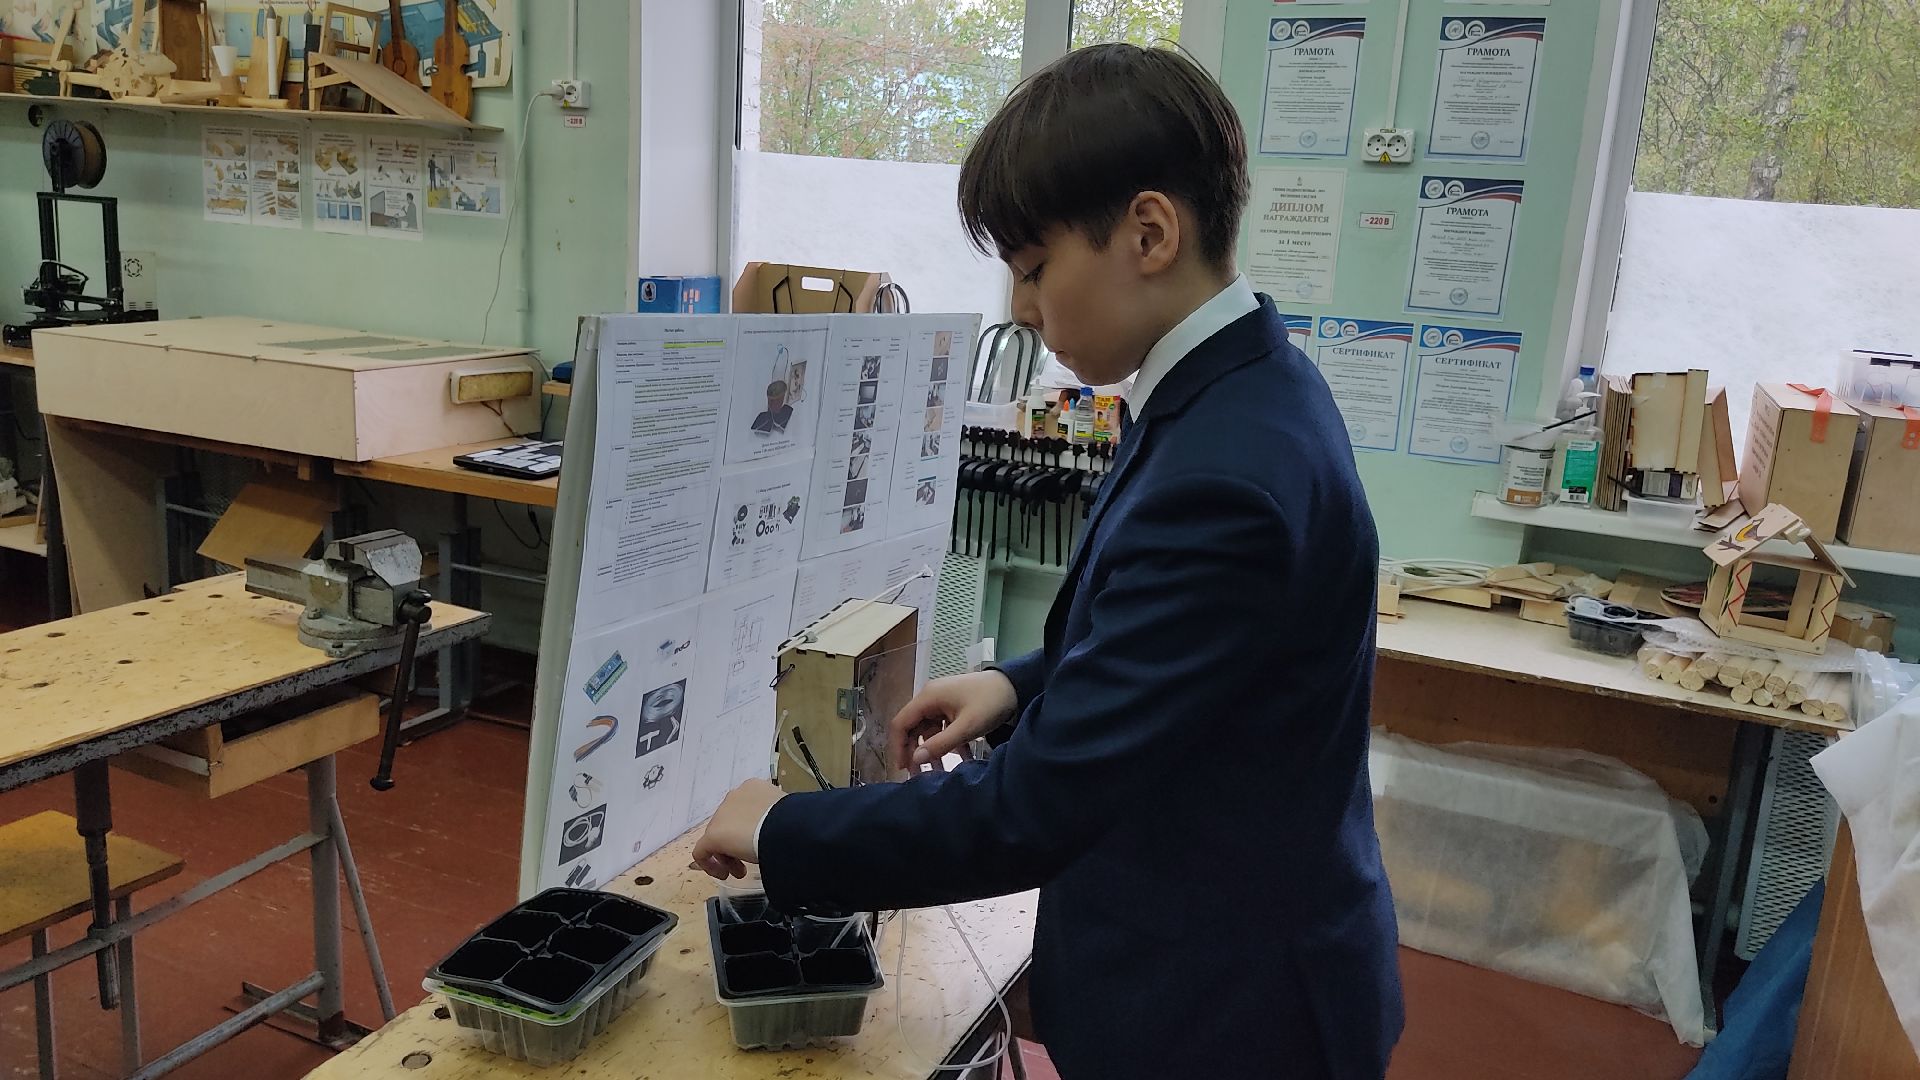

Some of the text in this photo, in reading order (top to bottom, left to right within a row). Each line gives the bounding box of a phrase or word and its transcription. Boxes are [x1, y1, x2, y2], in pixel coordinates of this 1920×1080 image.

[1293, 47, 1335, 56] ГРАМОТА
[1466, 47, 1511, 57] ГРАМОТА
[1269, 202, 1324, 213] ДИПЛОМ
[1446, 207, 1489, 217] ГРАМОТА
[1263, 214, 1329, 223] НАГРАЖДАЕТСЯ
[1332, 347, 1396, 359] СЕРТИФИКАТ
[1435, 357, 1502, 369] СЕРТИФИКАТ
